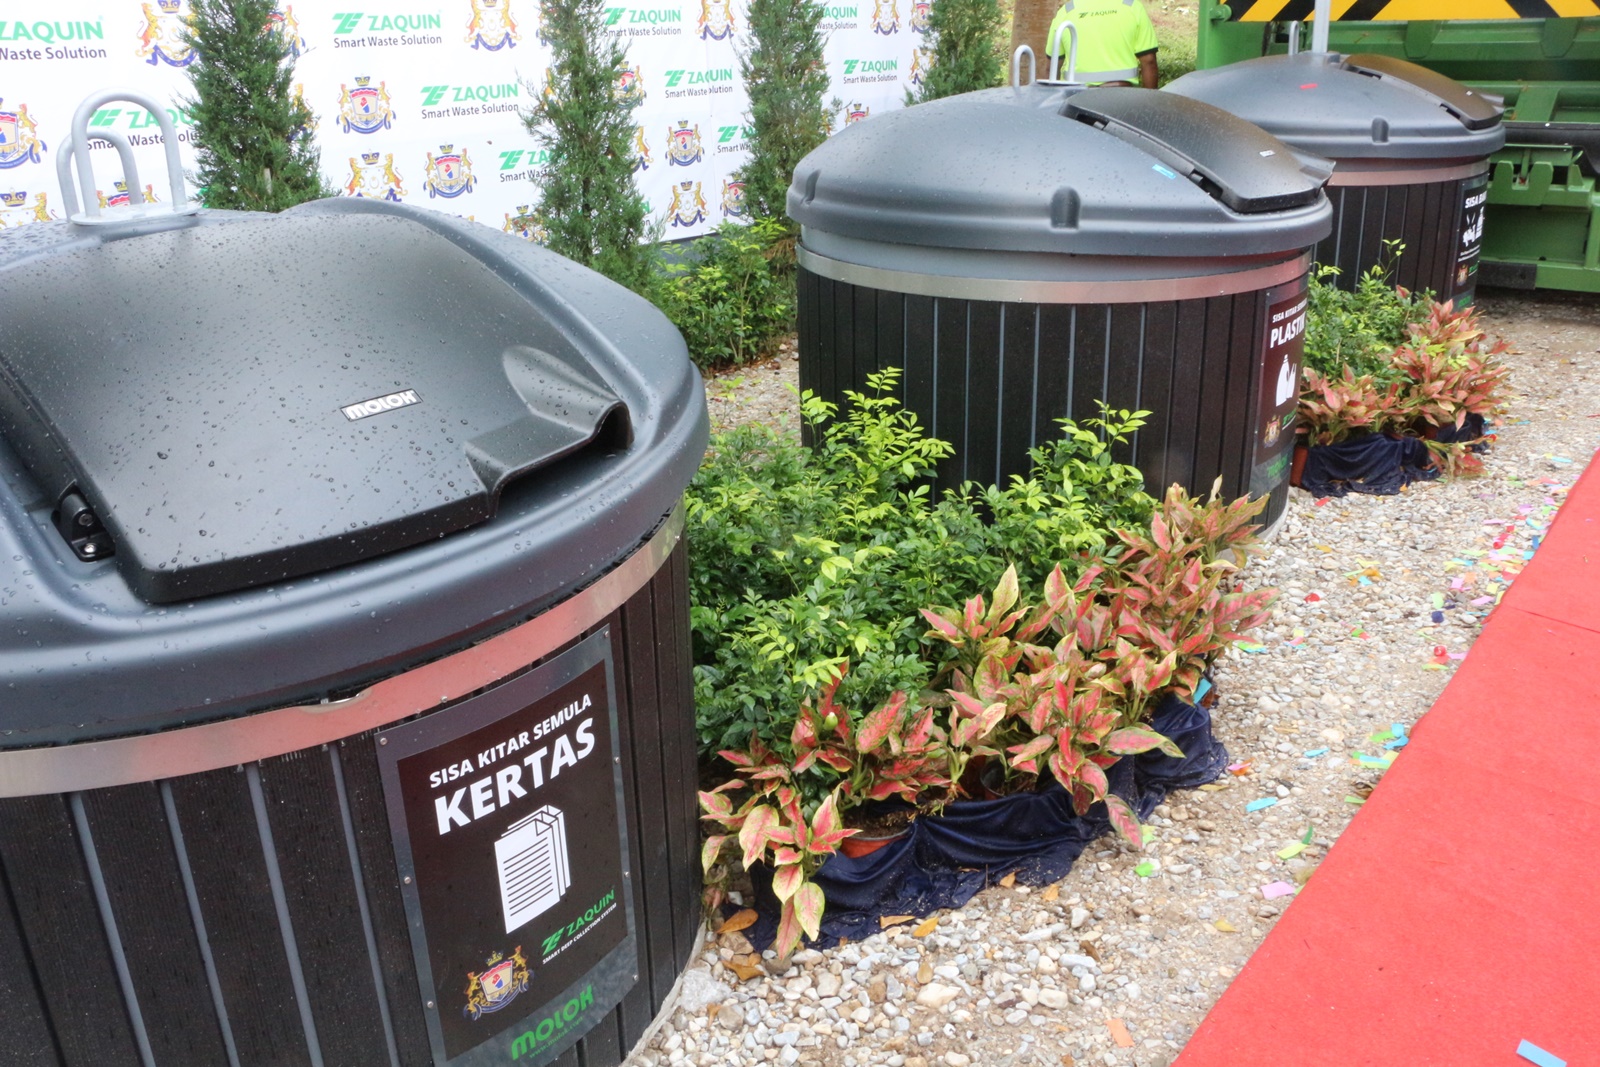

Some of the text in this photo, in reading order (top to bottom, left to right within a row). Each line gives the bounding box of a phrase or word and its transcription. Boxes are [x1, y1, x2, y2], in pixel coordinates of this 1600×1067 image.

[628, 9, 682, 25] ZAQUIN
[823, 6, 857, 20] AQUIN
[367, 13, 441, 33] ZAQUIN
[834, 21, 858, 29] Solution
[0, 21, 104, 44] ZAQUIN
[627, 27, 651, 37] Waste
[651, 26, 682, 36] Solution
[333, 34, 443, 49] Smart Waste Solution
[45, 46, 107, 60] Solution
[860, 59, 898, 73] ZAQUIN
[843, 73, 898, 85] Smart Waste Solution
[452, 83, 519, 103] ZAQUIN
[665, 89, 686, 99] Smart
[686, 88, 708, 97] Waste
[421, 102, 519, 120] Smart Waste Solution
[717, 144, 739, 154] Smart
[499, 171, 527, 183] Smart
[1272, 311, 1285, 324] SISA
[345, 389, 417, 420] MOLOK
[429, 693, 593, 789] SISA KITAR SEMULA
[434, 716, 596, 836] KERTAS
[566, 888, 616, 938] ZAQUIN
[542, 902, 618, 966] SMART DEEP COLLECTION SYSTEM
[511, 983, 594, 1061] MOLOK
